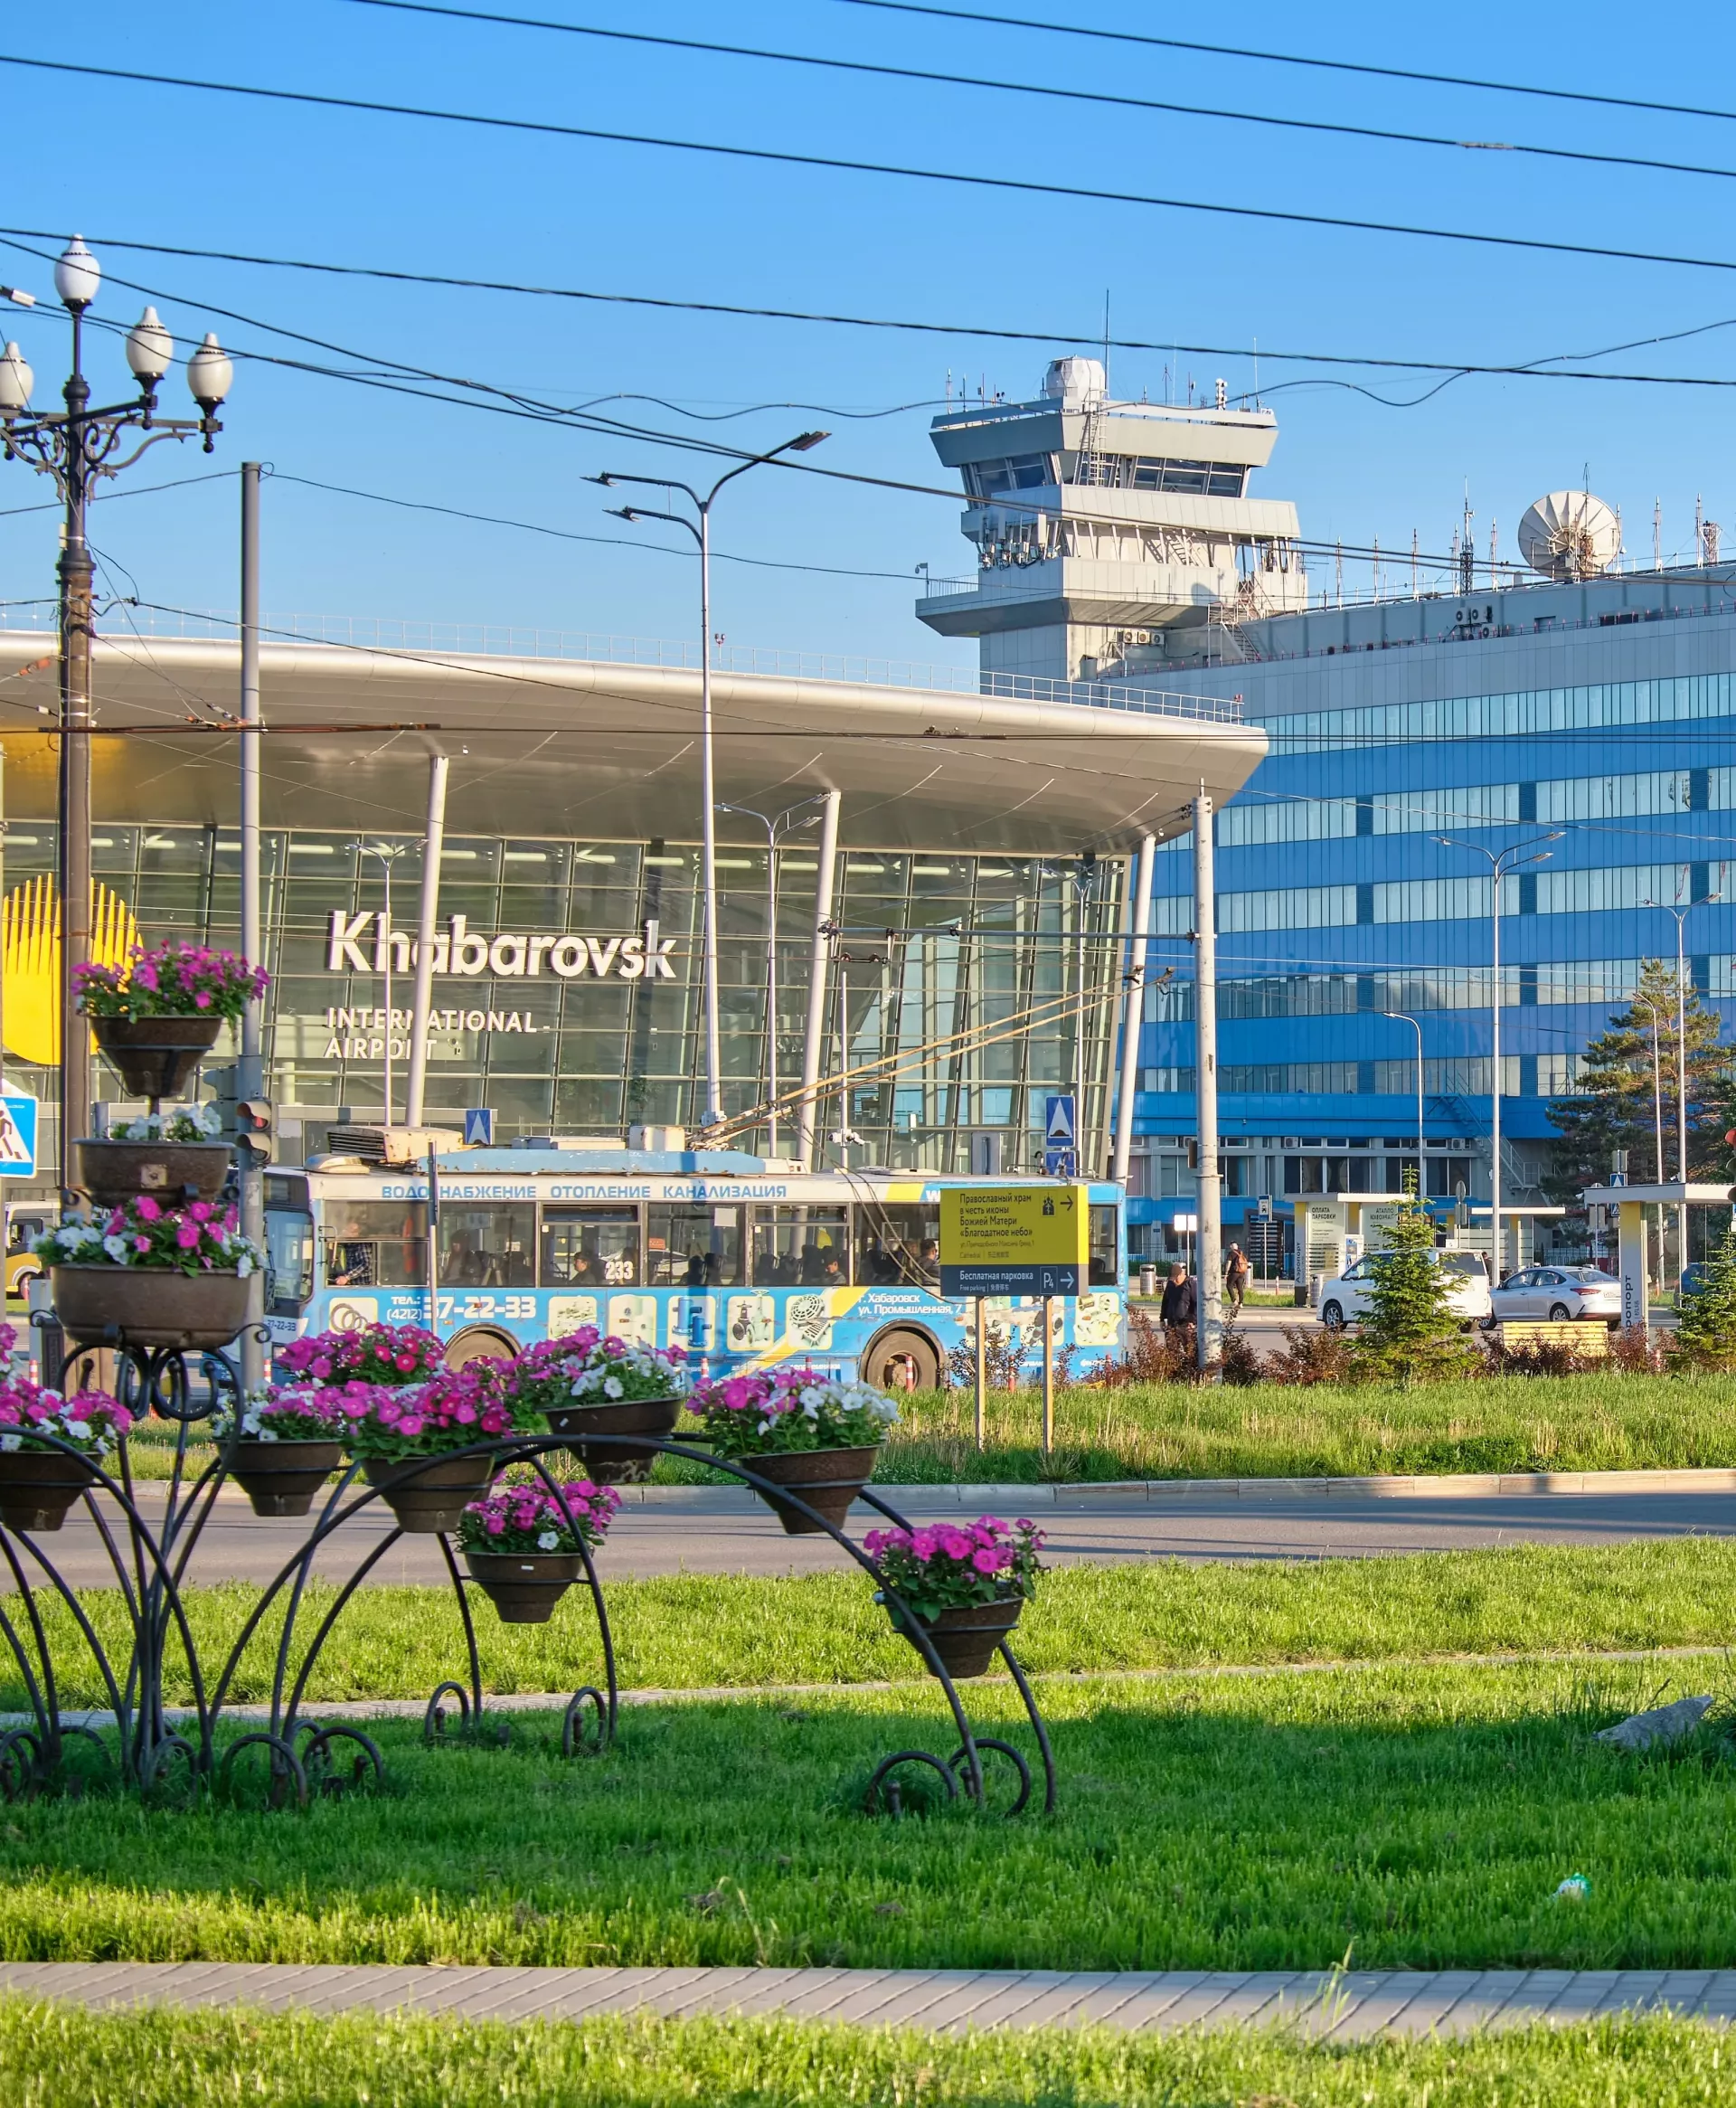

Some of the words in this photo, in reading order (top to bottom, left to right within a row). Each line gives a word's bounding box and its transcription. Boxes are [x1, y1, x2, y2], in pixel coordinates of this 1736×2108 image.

[329, 910, 677, 978] Khabarovsk
[382, 1186, 536, 1198] ВОДОНАБЖЕНИЕ
[550, 1186, 651, 1198] ОТОПЛЕНИЕ
[663, 1186, 787, 1198] КАНАЛИЗАЦИЯ
[960, 1192, 1013, 1205] Православный
[1014, 1195, 1032, 1205] храм
[960, 1216, 988, 1225] Божией
[989, 1215, 1017, 1226] Матери
[959, 1226, 1010, 1238] «Благодатное
[1011, 1226, 1033, 1236] небо»
[605, 1261, 633, 1280] 233
[959, 1271, 999, 1281] Бесплатная
[1001, 1271, 1033, 1282] парковка
[969, 1284, 986, 1292] parking
[868, 1293, 920, 1306] Хабаровск
[423, 1296, 536, 1319] 37-22-33
[858, 1307, 872, 1316] ул.
[873, 1304, 953, 1315] Промышленная,
[955, 1304, 963, 1313] 7
[267, 1319, 297, 1332] 37-22-33
